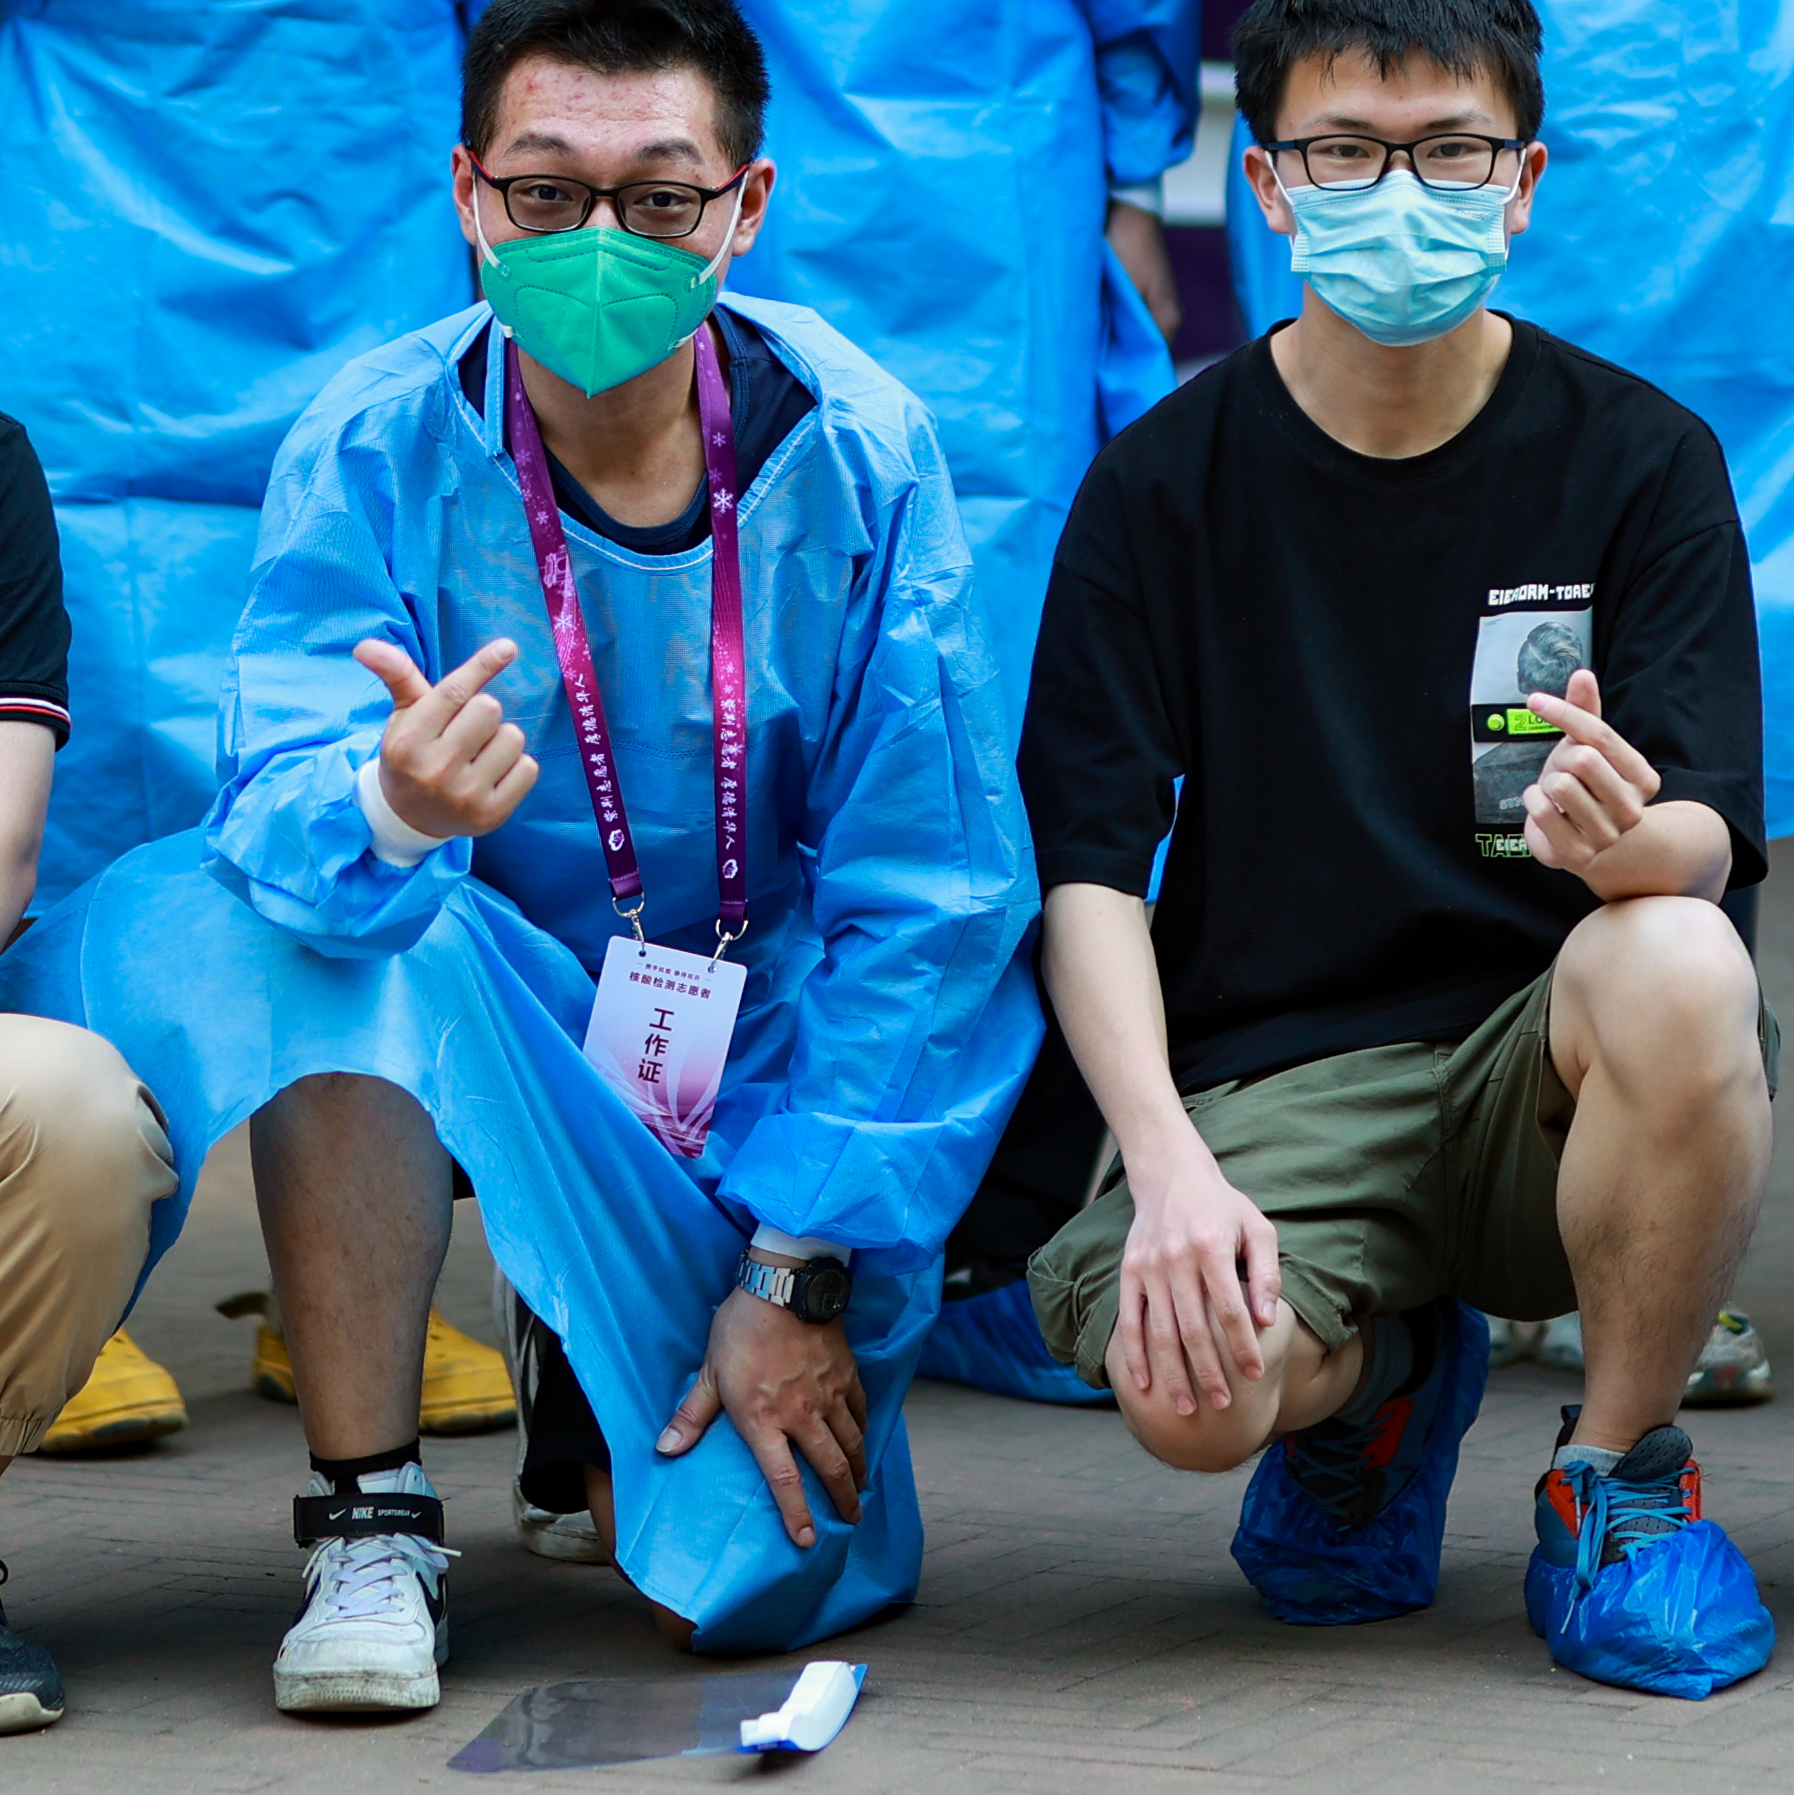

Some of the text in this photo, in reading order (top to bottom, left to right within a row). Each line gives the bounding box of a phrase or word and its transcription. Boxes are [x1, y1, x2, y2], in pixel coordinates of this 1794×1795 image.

[629, 971, 711, 999] 核酸检测志愿者
[637, 1008, 674, 1083] 工作证
[352, 1506, 374, 1520] NIKE
